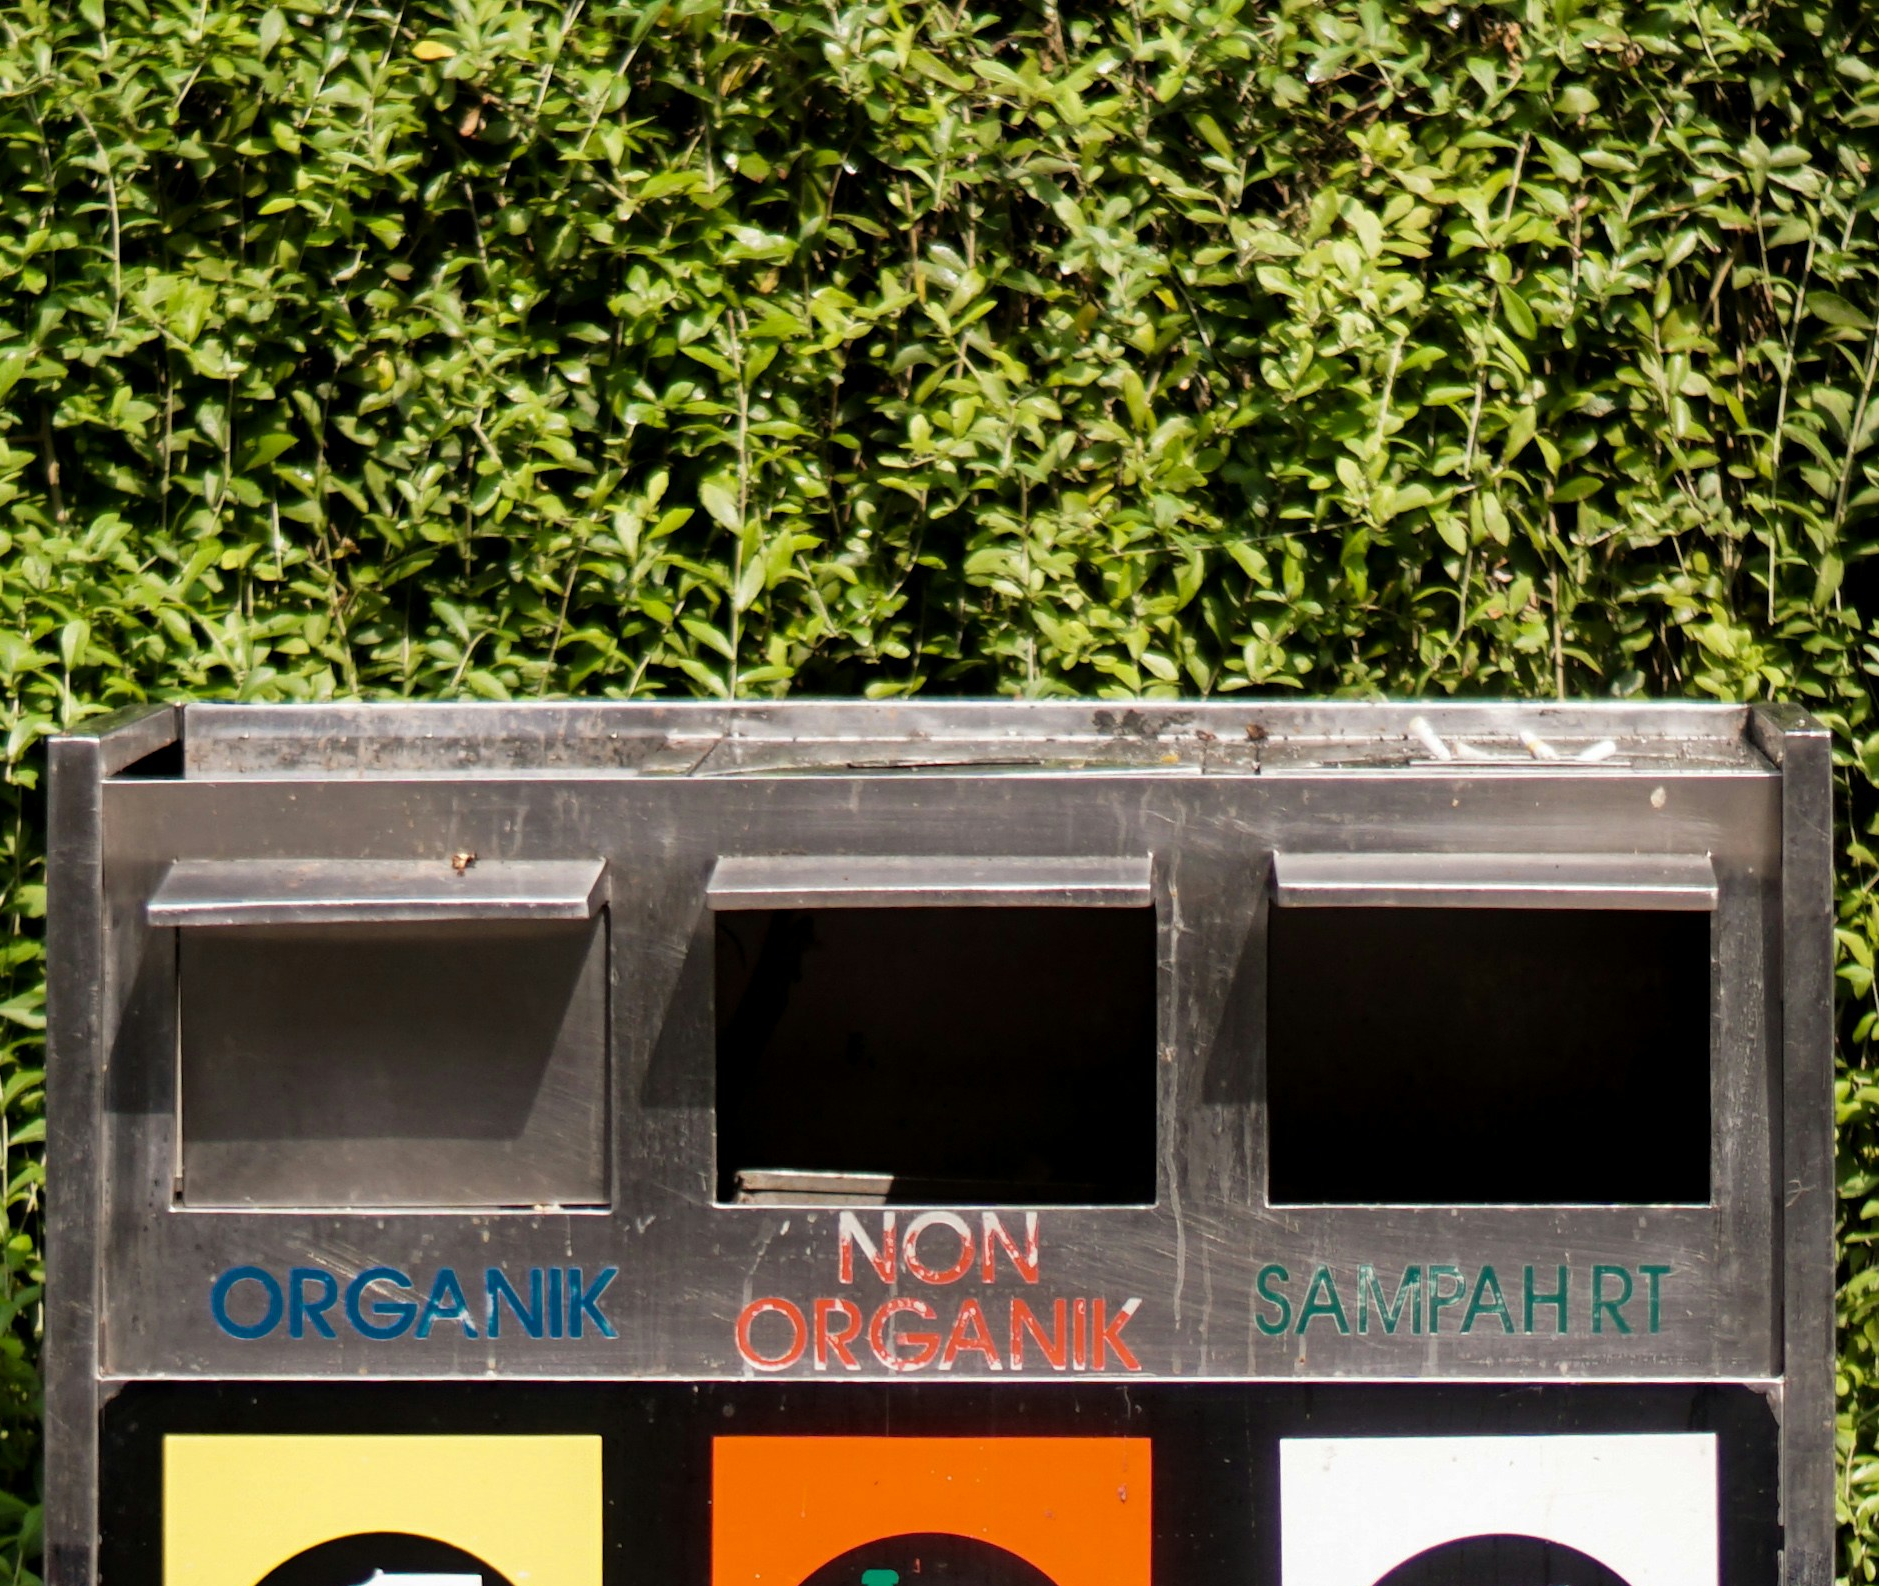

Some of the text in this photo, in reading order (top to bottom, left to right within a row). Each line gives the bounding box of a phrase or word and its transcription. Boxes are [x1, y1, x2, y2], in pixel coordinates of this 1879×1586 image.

[838, 1210, 1041, 1286] NON
[211, 1266, 618, 1340] ORGANIK
[734, 1297, 1143, 1372] ORGANIK
[1255, 1265, 1671, 1336] SAMPAH RT
